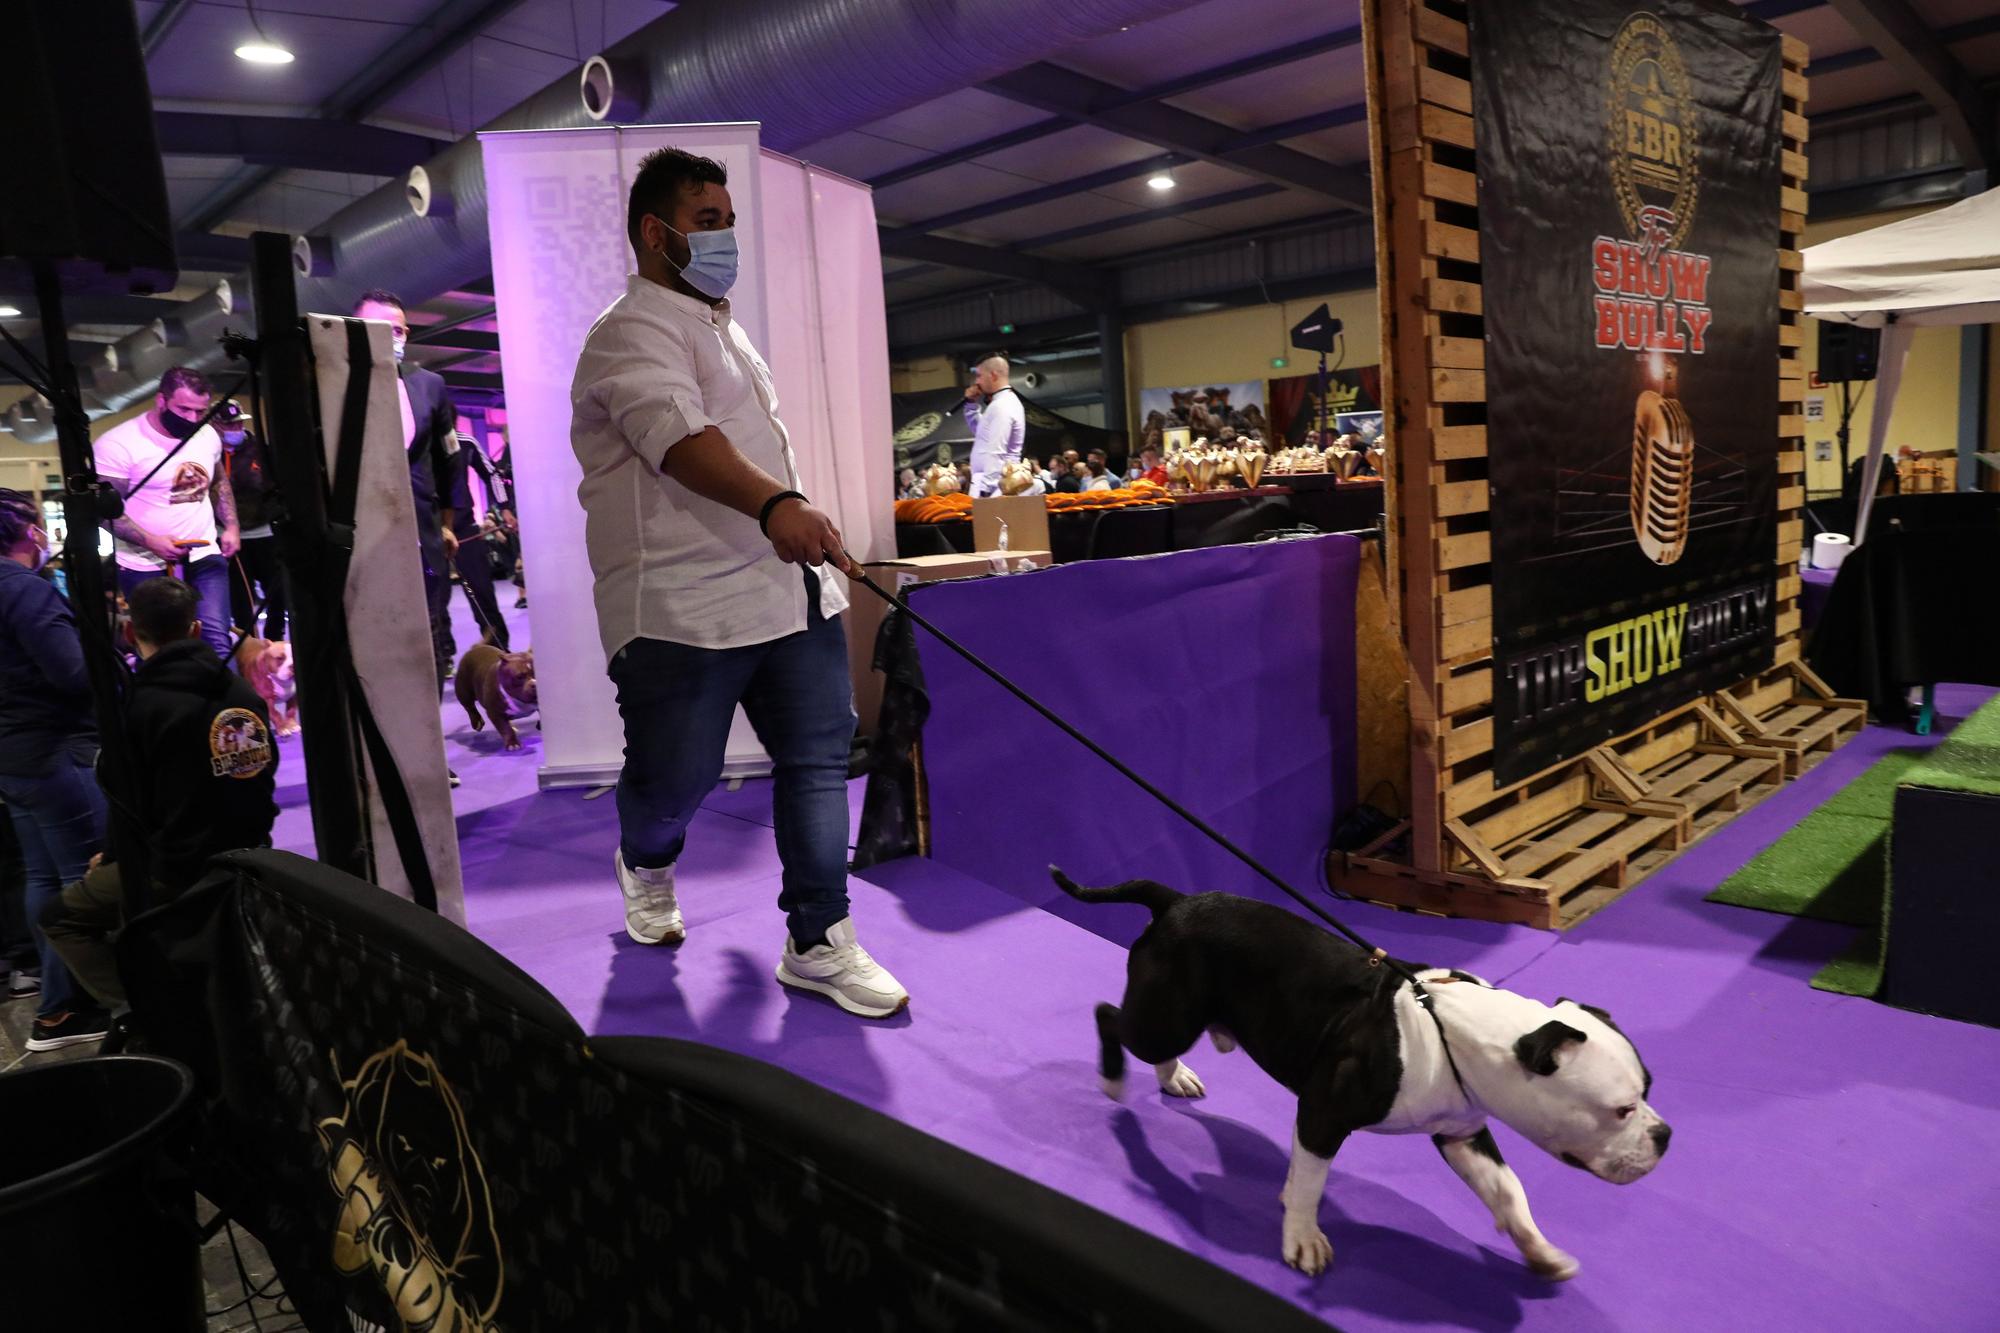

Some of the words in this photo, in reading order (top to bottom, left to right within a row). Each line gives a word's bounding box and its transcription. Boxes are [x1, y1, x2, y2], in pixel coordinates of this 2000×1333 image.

[1626, 111, 1682, 167] EBR
[1592, 235, 1711, 305] SHOW
[1594, 294, 1712, 354] BULLY
[1585, 604, 1688, 702] SHOW
